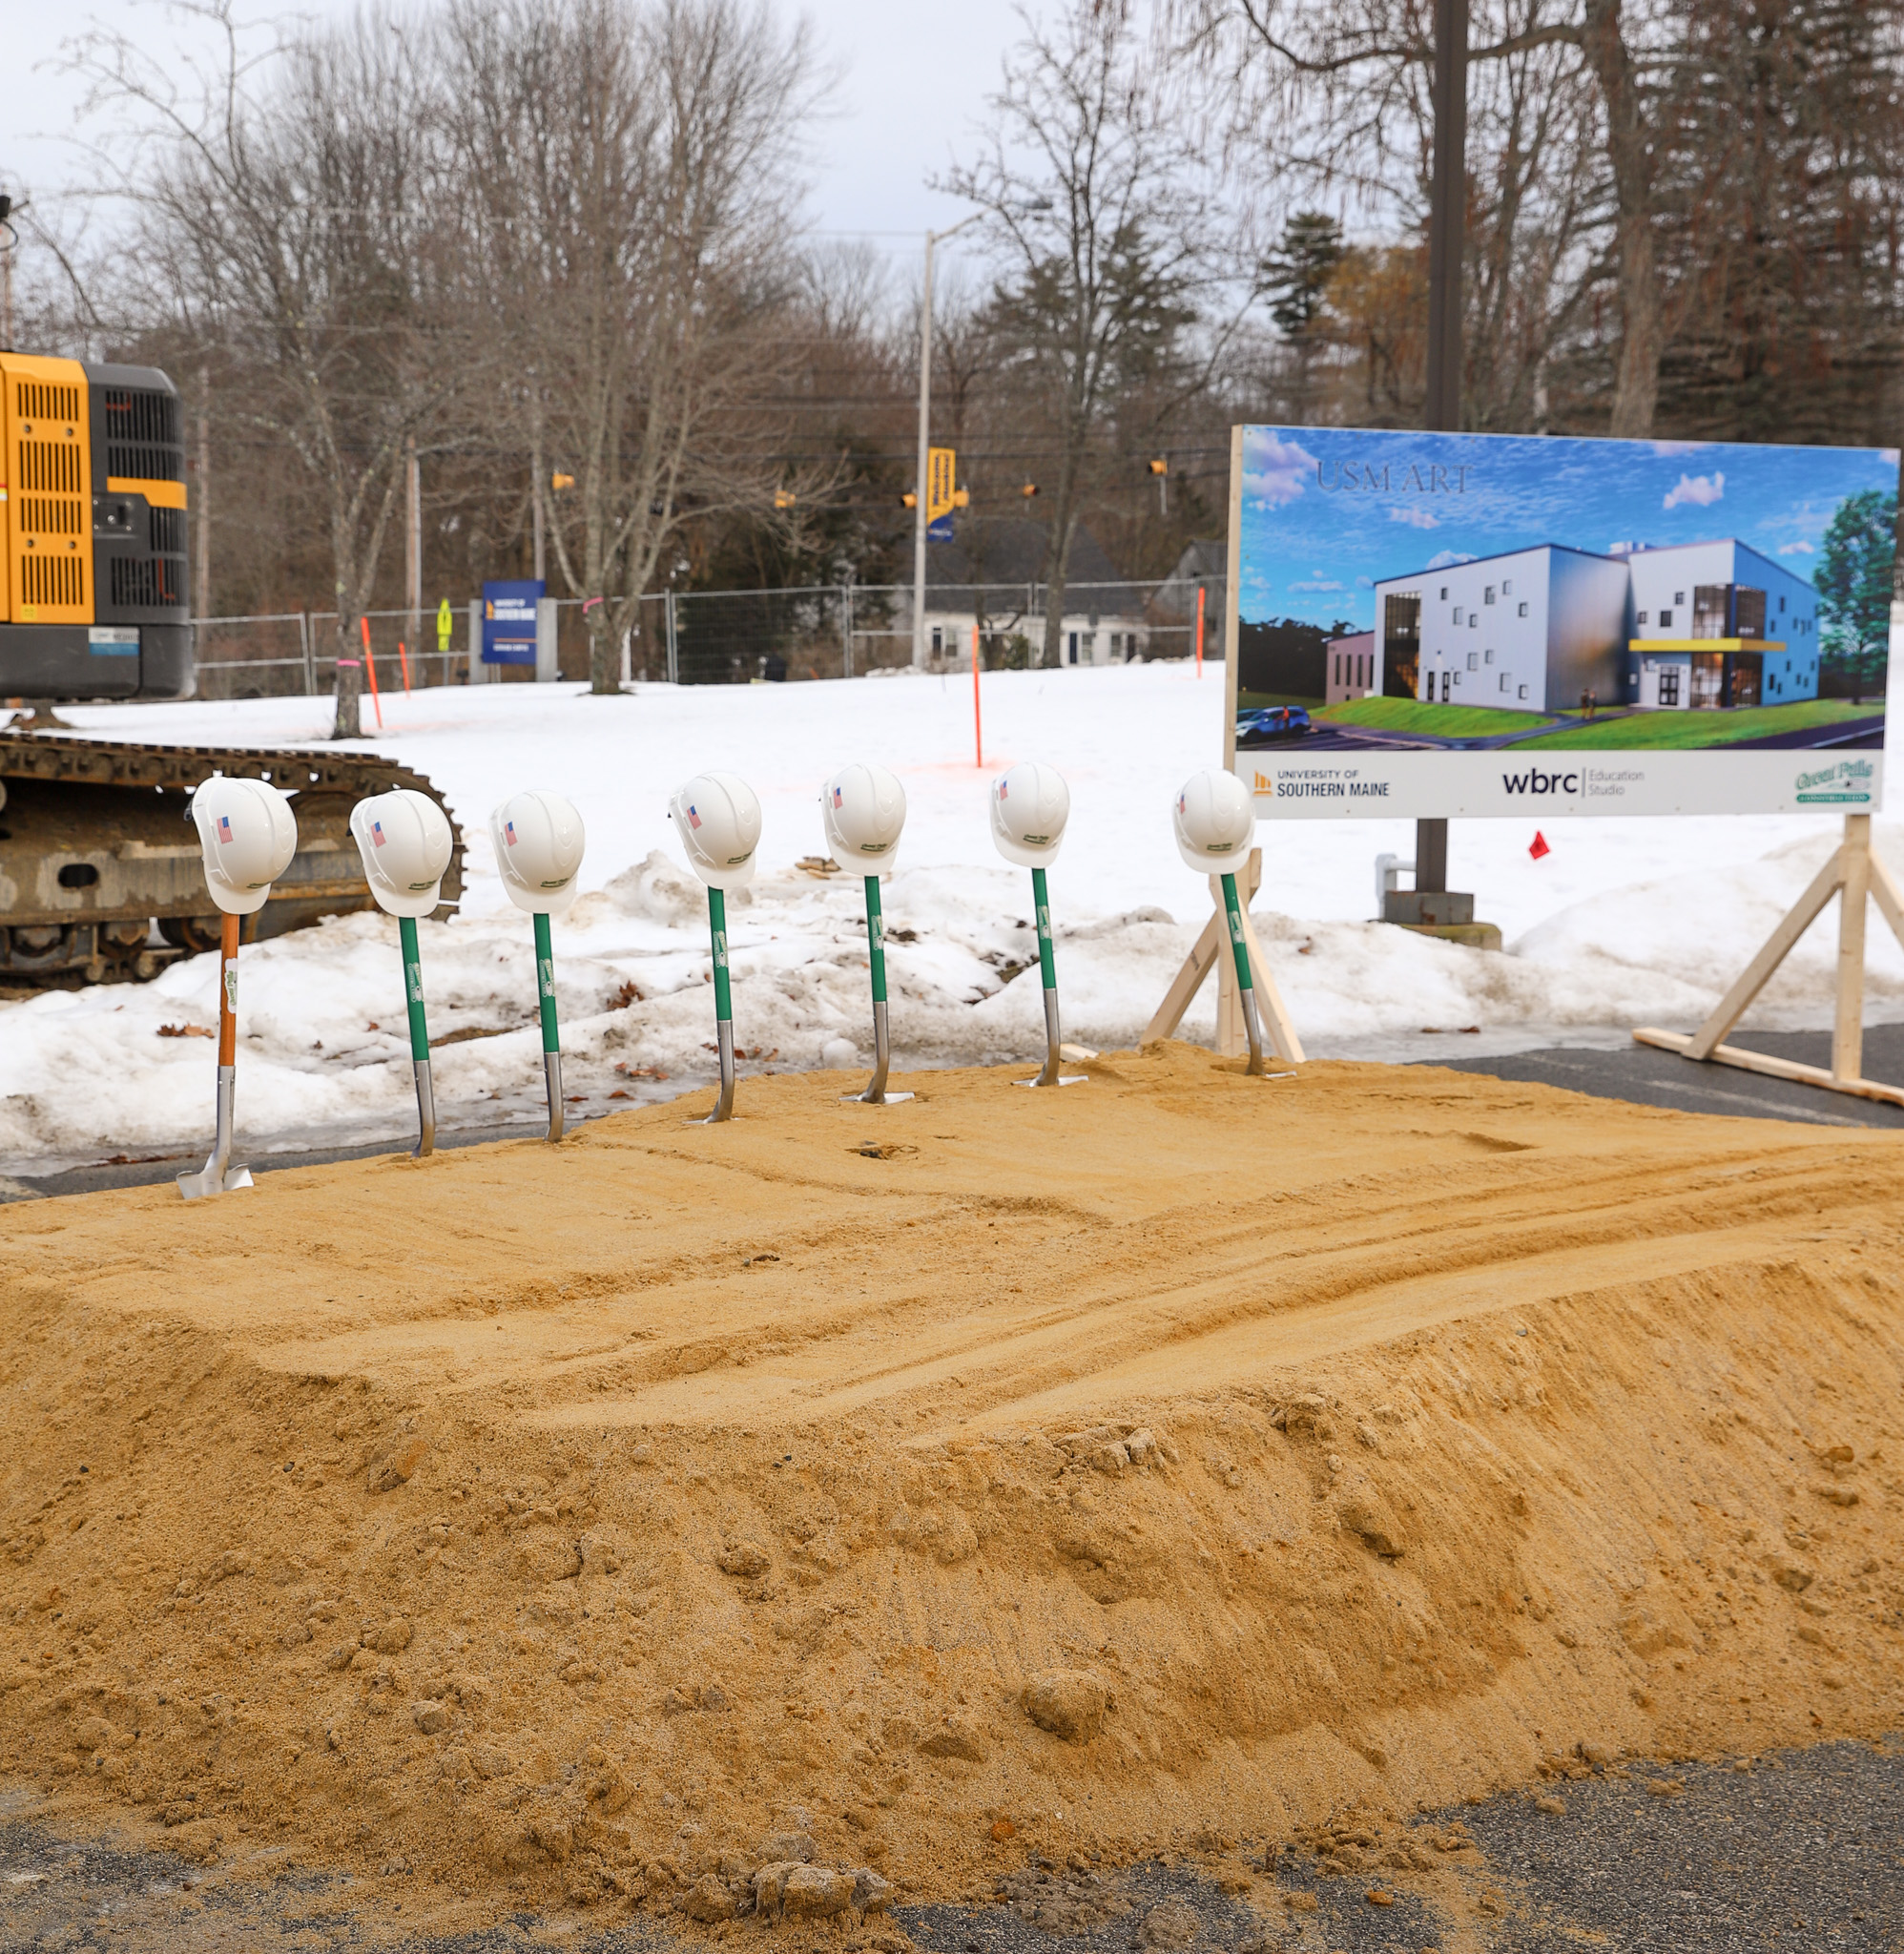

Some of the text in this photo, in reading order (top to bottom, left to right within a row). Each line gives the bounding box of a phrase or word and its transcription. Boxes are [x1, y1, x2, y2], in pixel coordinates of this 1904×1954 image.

[1316, 460, 1474, 494] USM ART
[1277, 770, 1359, 780] UNIVERSITY OF
[1502, 768, 1579, 795] wbrc
[1589, 769, 1645, 781] Education
[1277, 782, 1390, 798] SOUTHERN MAINE
[1589, 783, 1625, 796] Studio
